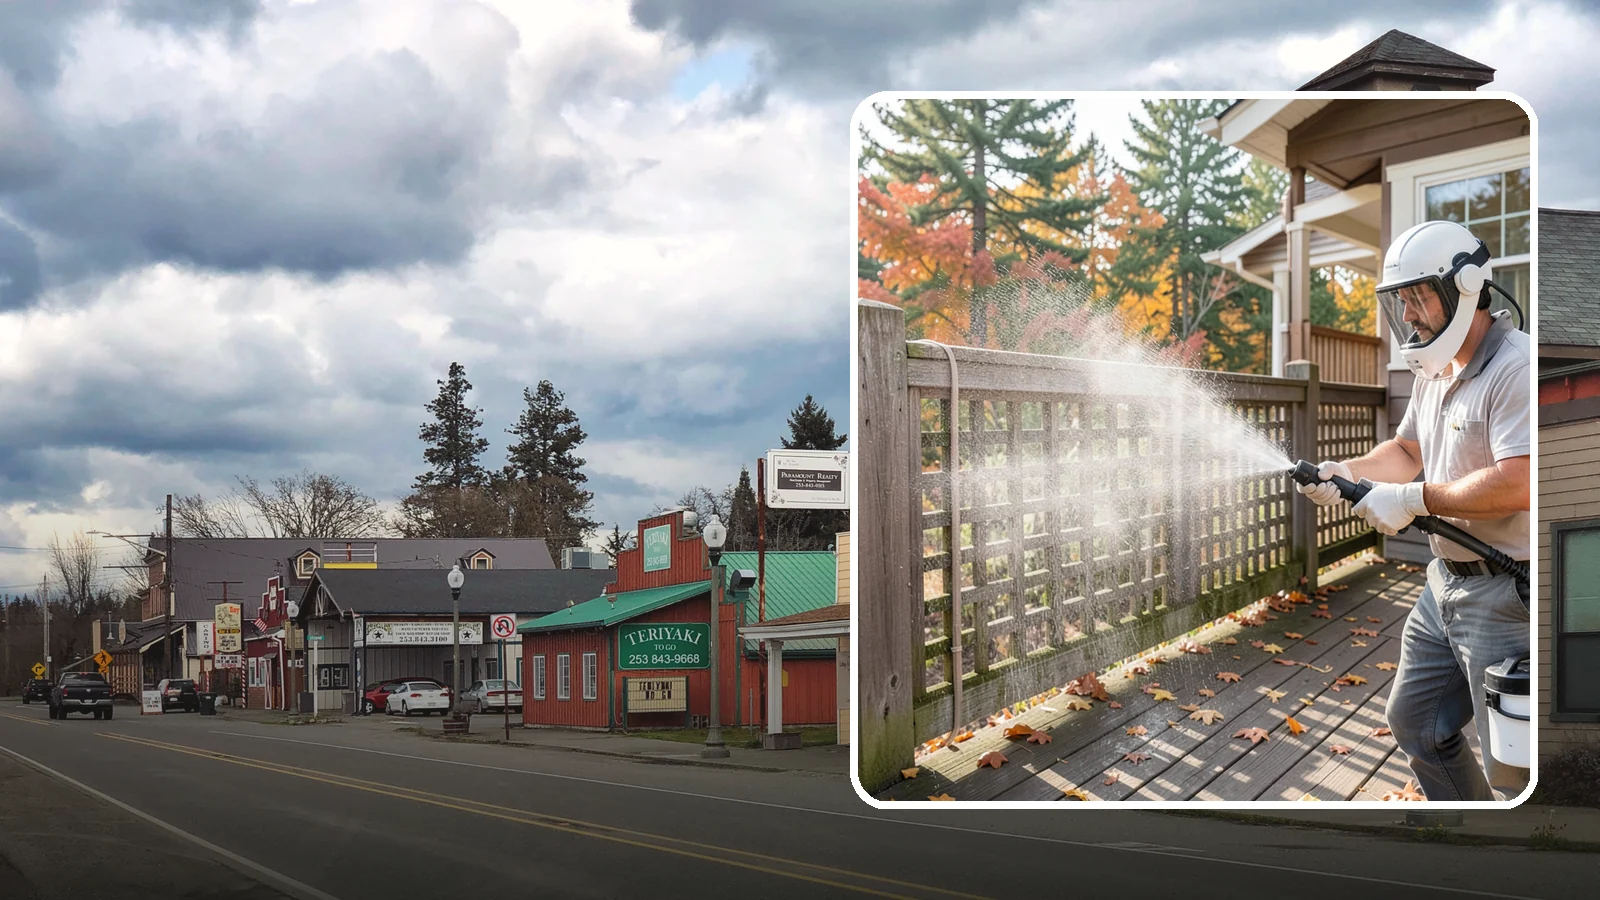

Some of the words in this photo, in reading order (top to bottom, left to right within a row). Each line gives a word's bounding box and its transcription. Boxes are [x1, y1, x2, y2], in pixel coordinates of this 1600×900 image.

[624, 627, 703, 646] TERIYAKI
[628, 654, 649, 665] 253
[651, 653, 700, 664] 843-9668
[639, 681, 673, 690] TERIYAKI
